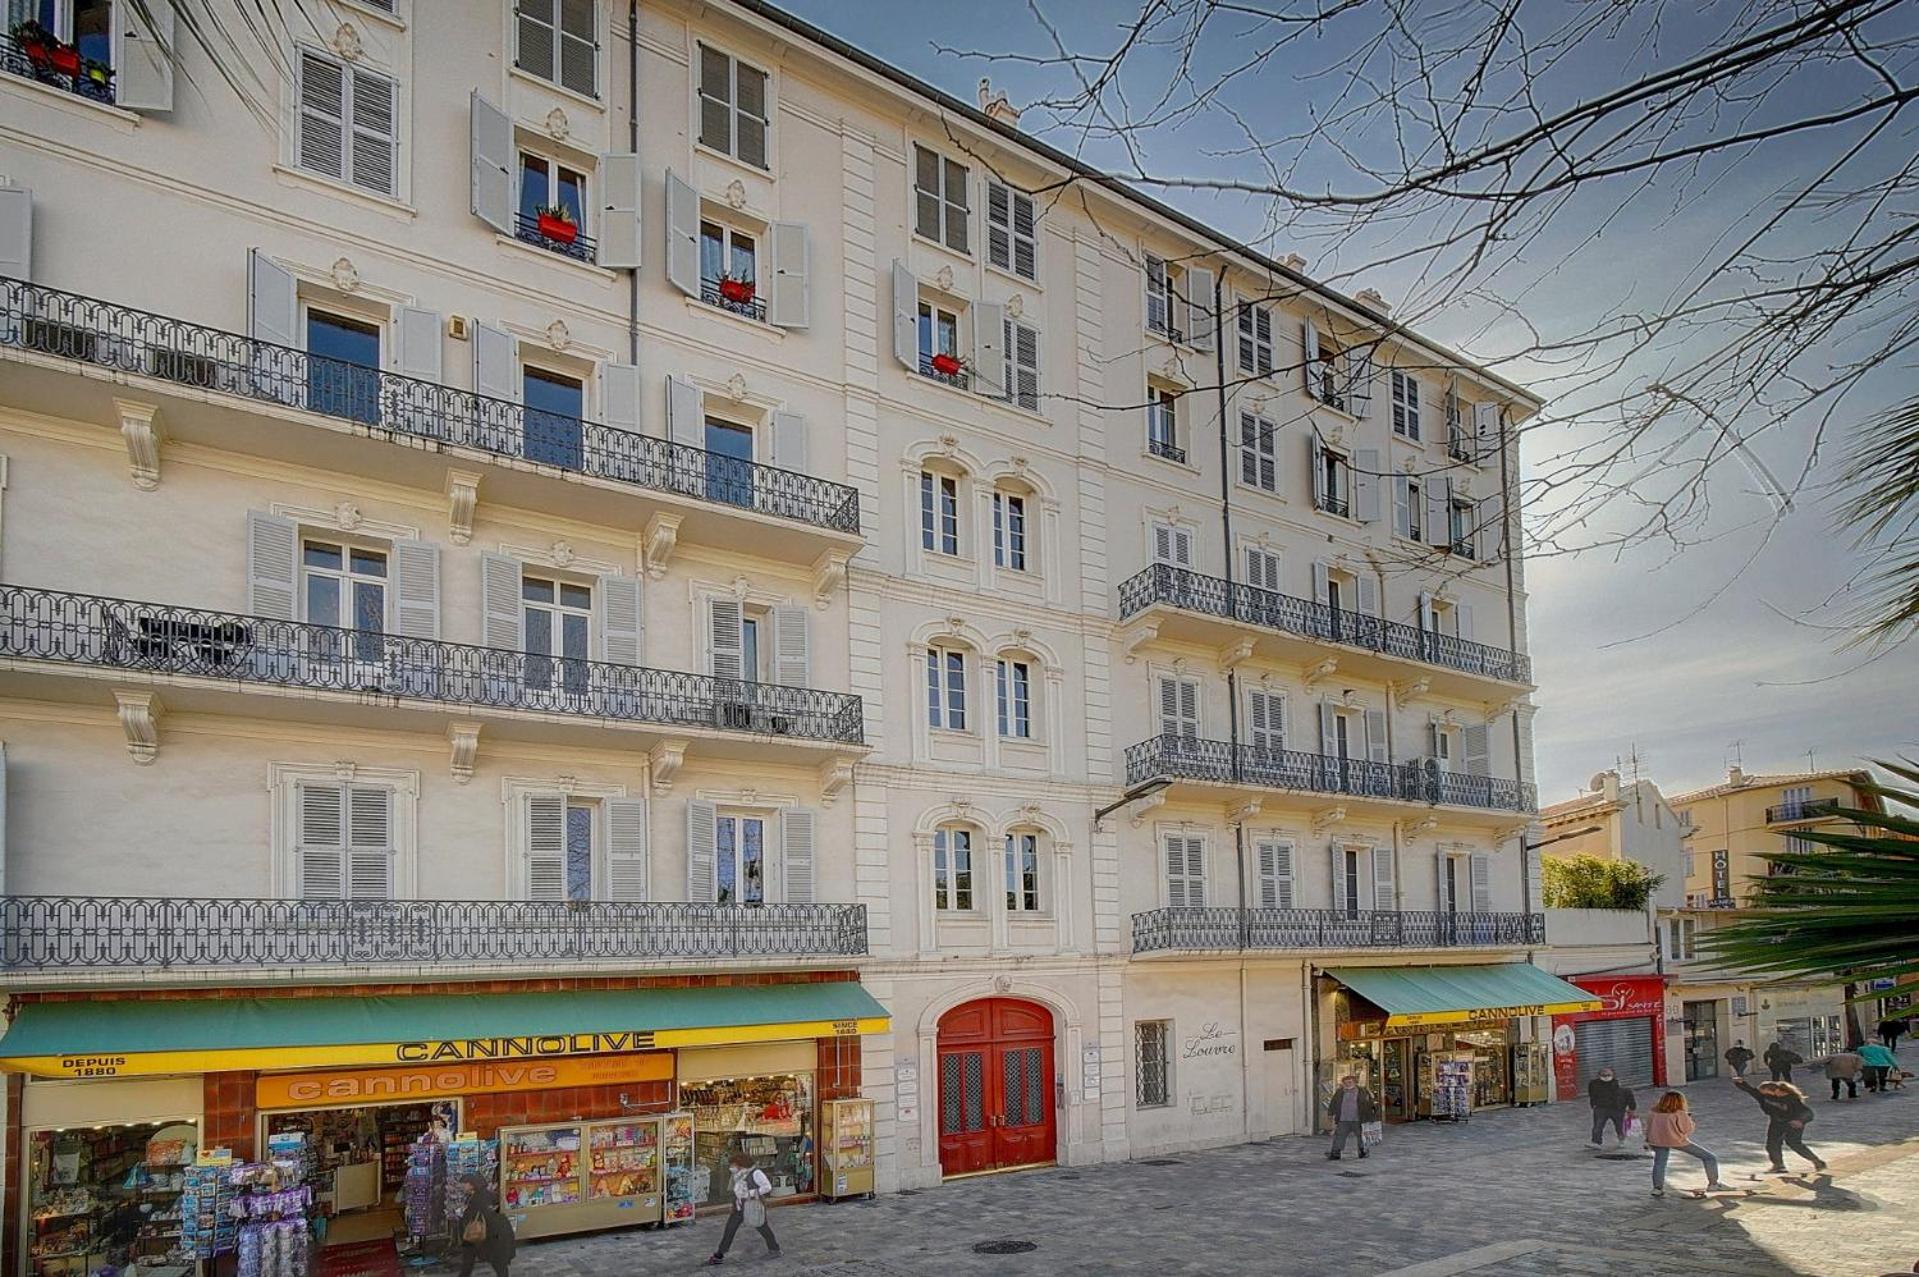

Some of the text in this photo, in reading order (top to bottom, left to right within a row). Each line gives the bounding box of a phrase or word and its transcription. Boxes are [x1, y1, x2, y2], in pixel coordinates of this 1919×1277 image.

[1714, 850, 1727, 898] HOTEL
[1468, 1004, 1544, 1020] CANNOLIVE
[832, 1021, 858, 1029] SINCE
[397, 1032, 656, 1062] CANNOLIVE
[1183, 1038, 1236, 1059] Louvre
[63, 1057, 126, 1068] DEPUIS
[73, 1066, 116, 1077] 1880
[288, 1064, 557, 1100] cannolive
